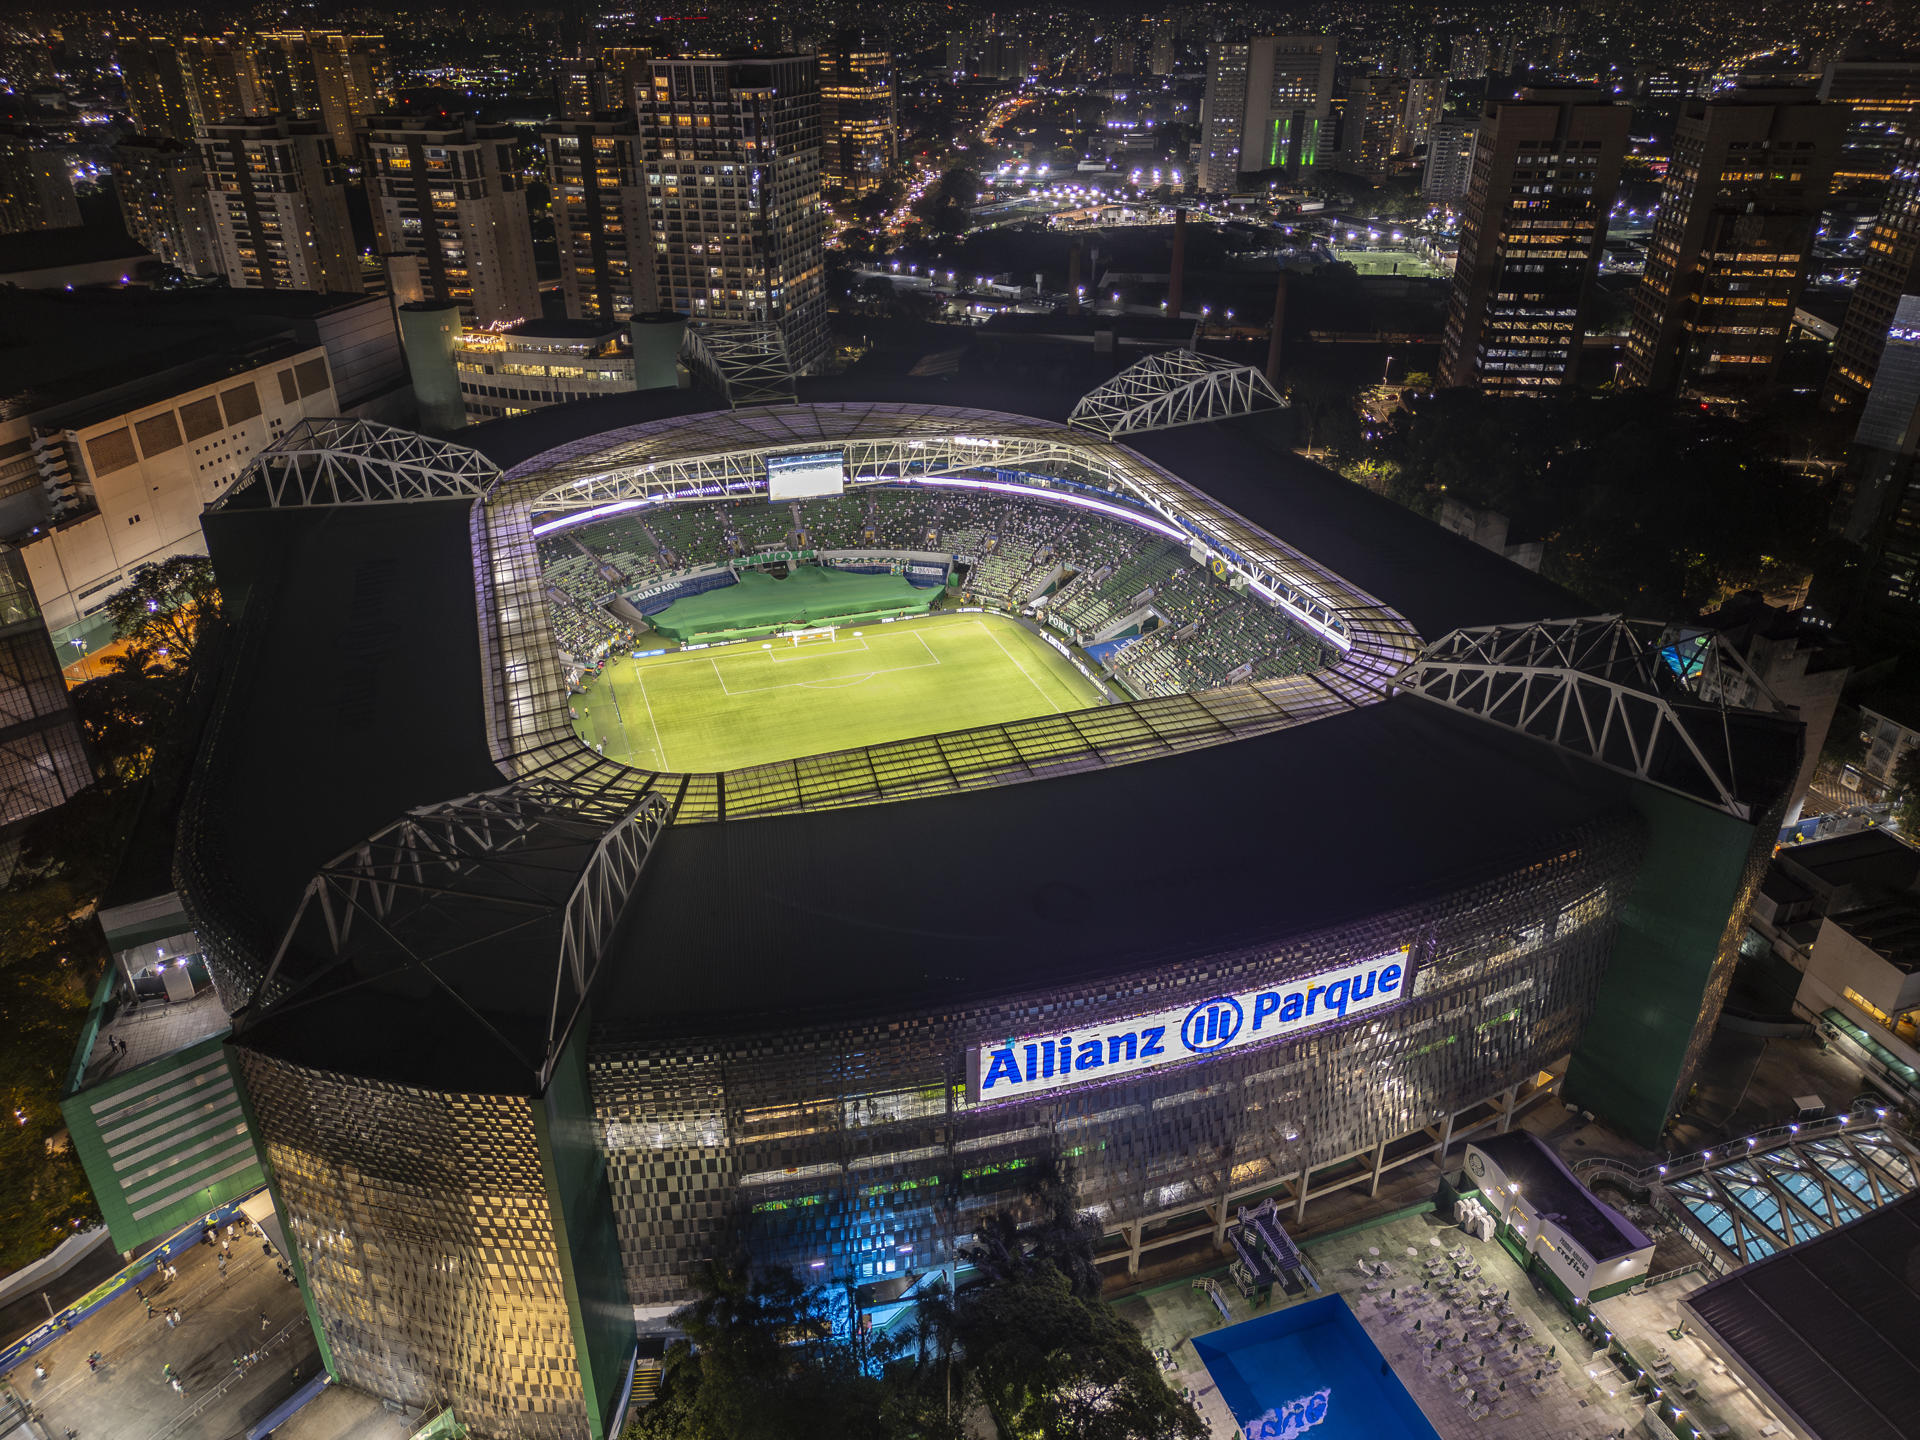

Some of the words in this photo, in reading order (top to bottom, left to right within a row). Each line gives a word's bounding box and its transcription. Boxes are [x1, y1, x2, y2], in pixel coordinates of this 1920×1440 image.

[732, 550, 815, 567] SAVOIA
[983, 1025, 1167, 1090] Allianz
[1255, 963, 1403, 1031] Parque
[1557, 1246, 1585, 1279] crefisa
